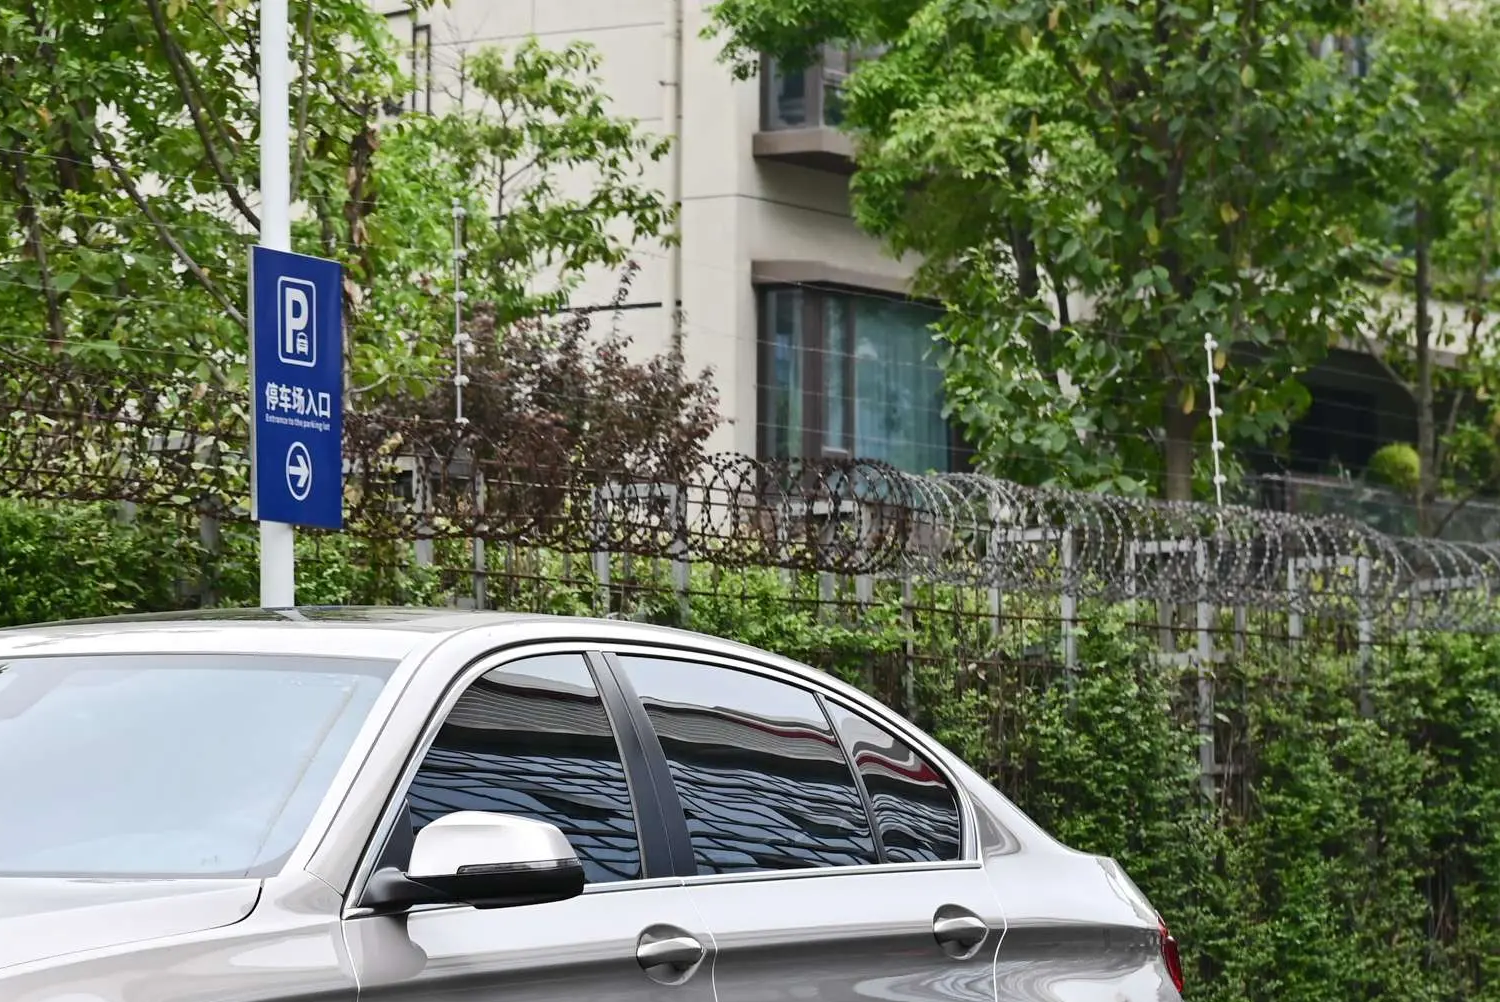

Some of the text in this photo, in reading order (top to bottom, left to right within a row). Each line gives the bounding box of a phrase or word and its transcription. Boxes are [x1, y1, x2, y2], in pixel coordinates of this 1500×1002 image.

[285, 286, 309, 354] P
[265, 381, 331, 419] 停车场入口
